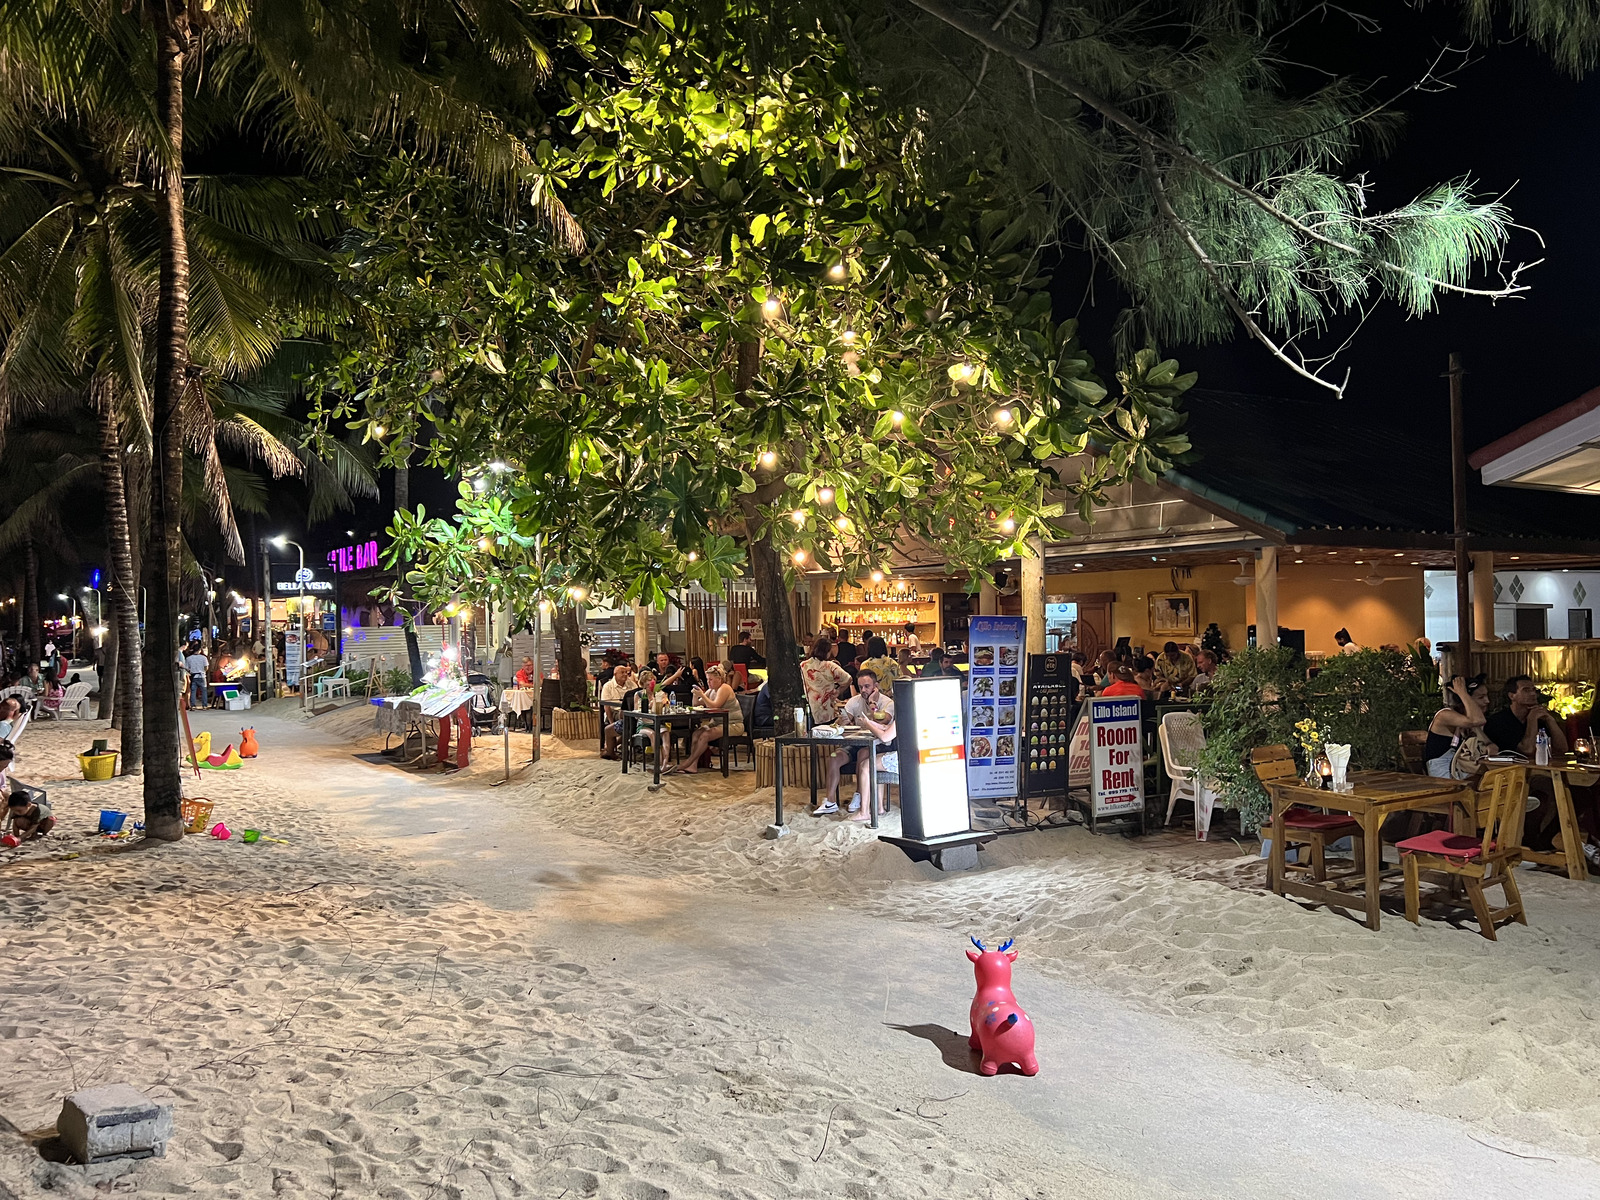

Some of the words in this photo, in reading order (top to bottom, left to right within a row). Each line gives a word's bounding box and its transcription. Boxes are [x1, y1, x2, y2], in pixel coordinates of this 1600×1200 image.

[356, 540, 379, 570] BAR
[276, 581, 305, 591] BELLA
[305, 581, 333, 590] VISTA
[1093, 705, 1111, 719] Lillo
[1112, 703, 1138, 717] Island
[1097, 726, 1138, 747] Room
[1109, 749, 1130, 766] For
[1102, 768, 1135, 790] Rent
